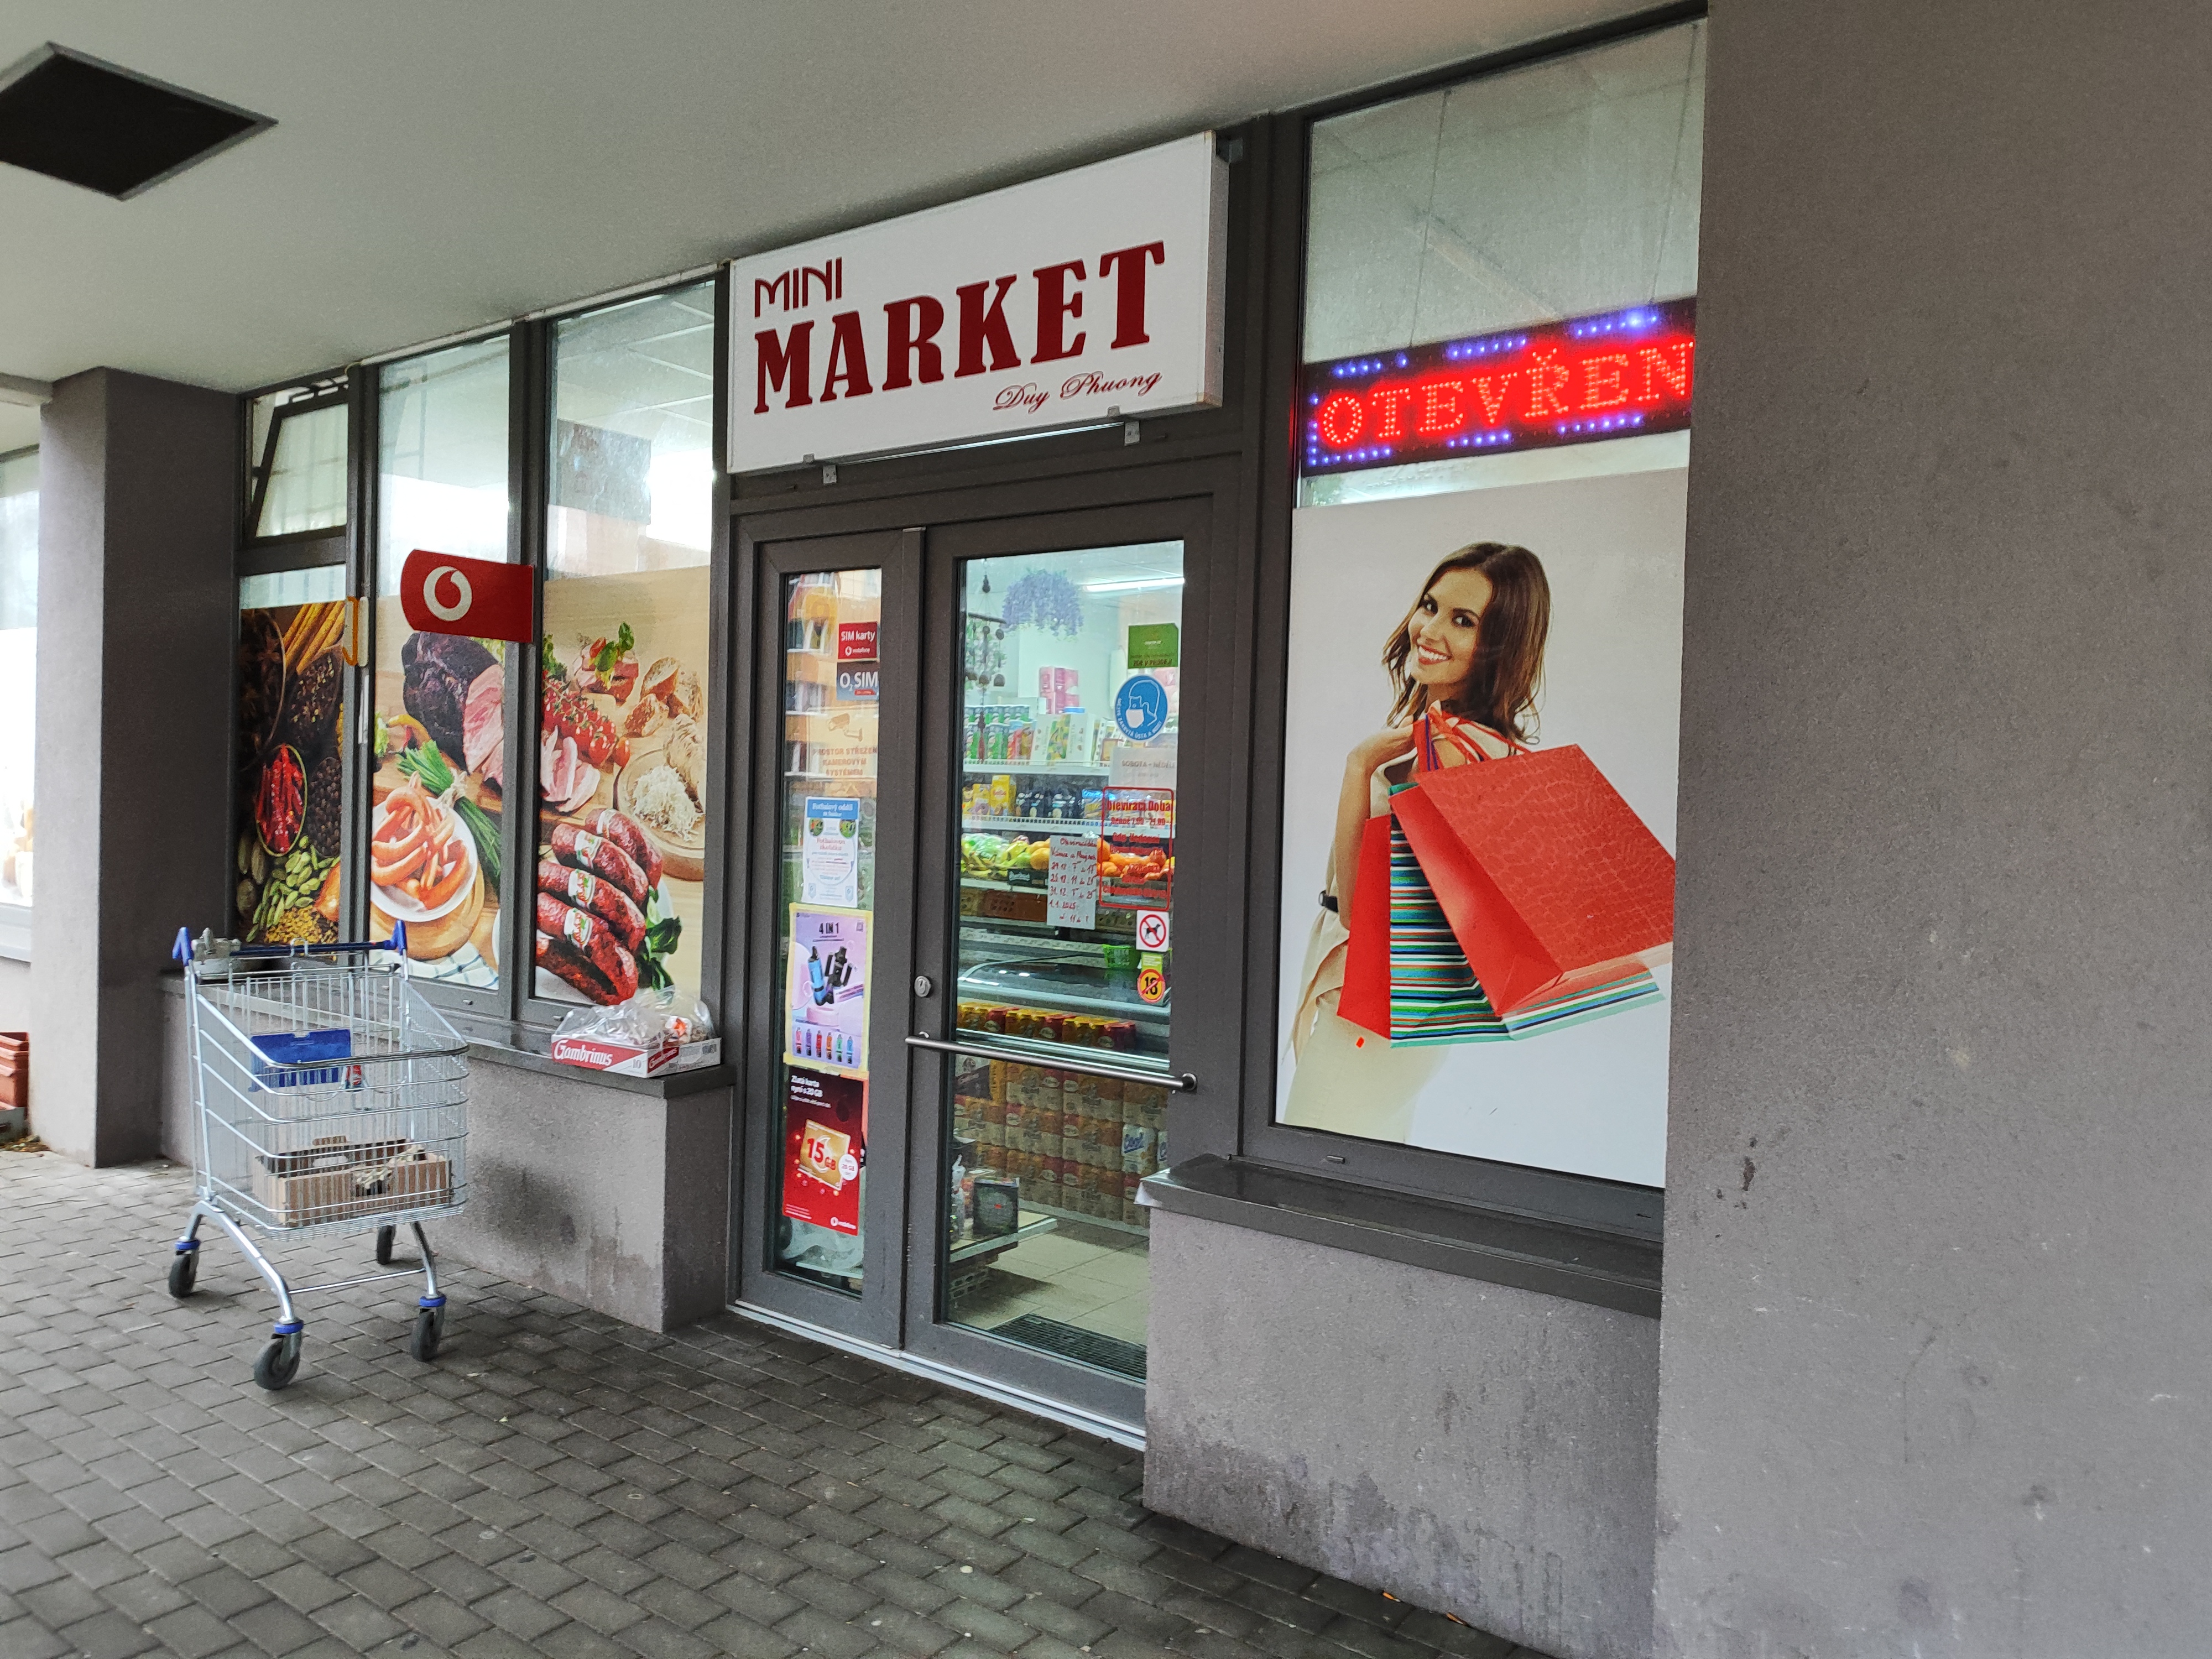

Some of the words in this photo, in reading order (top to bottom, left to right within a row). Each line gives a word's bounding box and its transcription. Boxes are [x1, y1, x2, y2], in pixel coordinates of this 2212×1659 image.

[754, 257, 843, 318] MINI
[754, 240, 1165, 414] MARKET
[993, 383, 1050, 415] Duy
[1060, 370, 1162, 410] Phuong
[1322, 339, 1694, 444] OTEVŘEN
[841, 630, 854, 641] SIM
[855, 630, 875, 643] karty
[854, 671, 879, 688] SIM
[818, 922, 824, 935] 4
[835, 921, 839, 934] 1
[1144, 977, 1159, 995] 18
[554, 1040, 613, 1066] Gambrinus
[807, 1138, 825, 1163] 15
